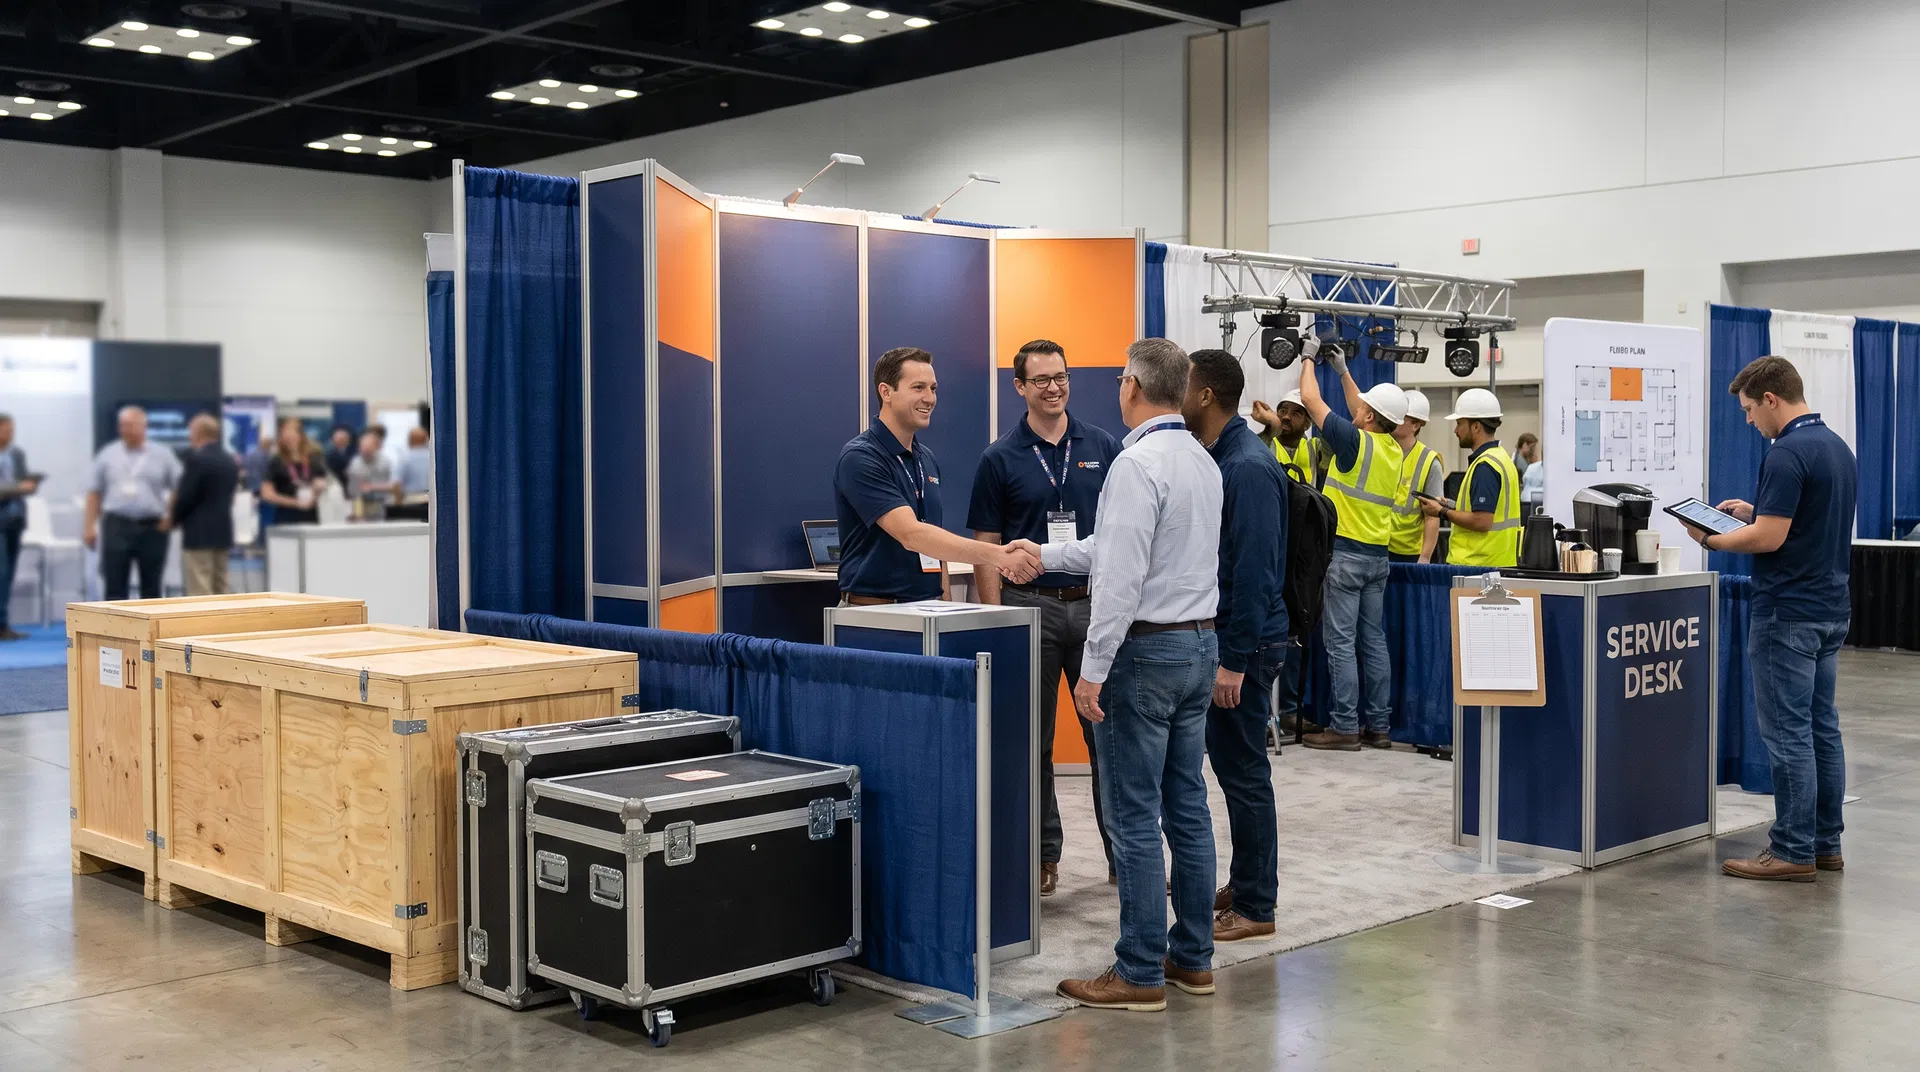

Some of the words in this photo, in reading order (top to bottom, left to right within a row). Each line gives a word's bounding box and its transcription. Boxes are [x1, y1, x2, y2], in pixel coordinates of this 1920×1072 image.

[1630, 347, 1645, 355] PLAN
[1607, 617, 1699, 659] SERVICE
[1625, 660, 1683, 699] DESK
